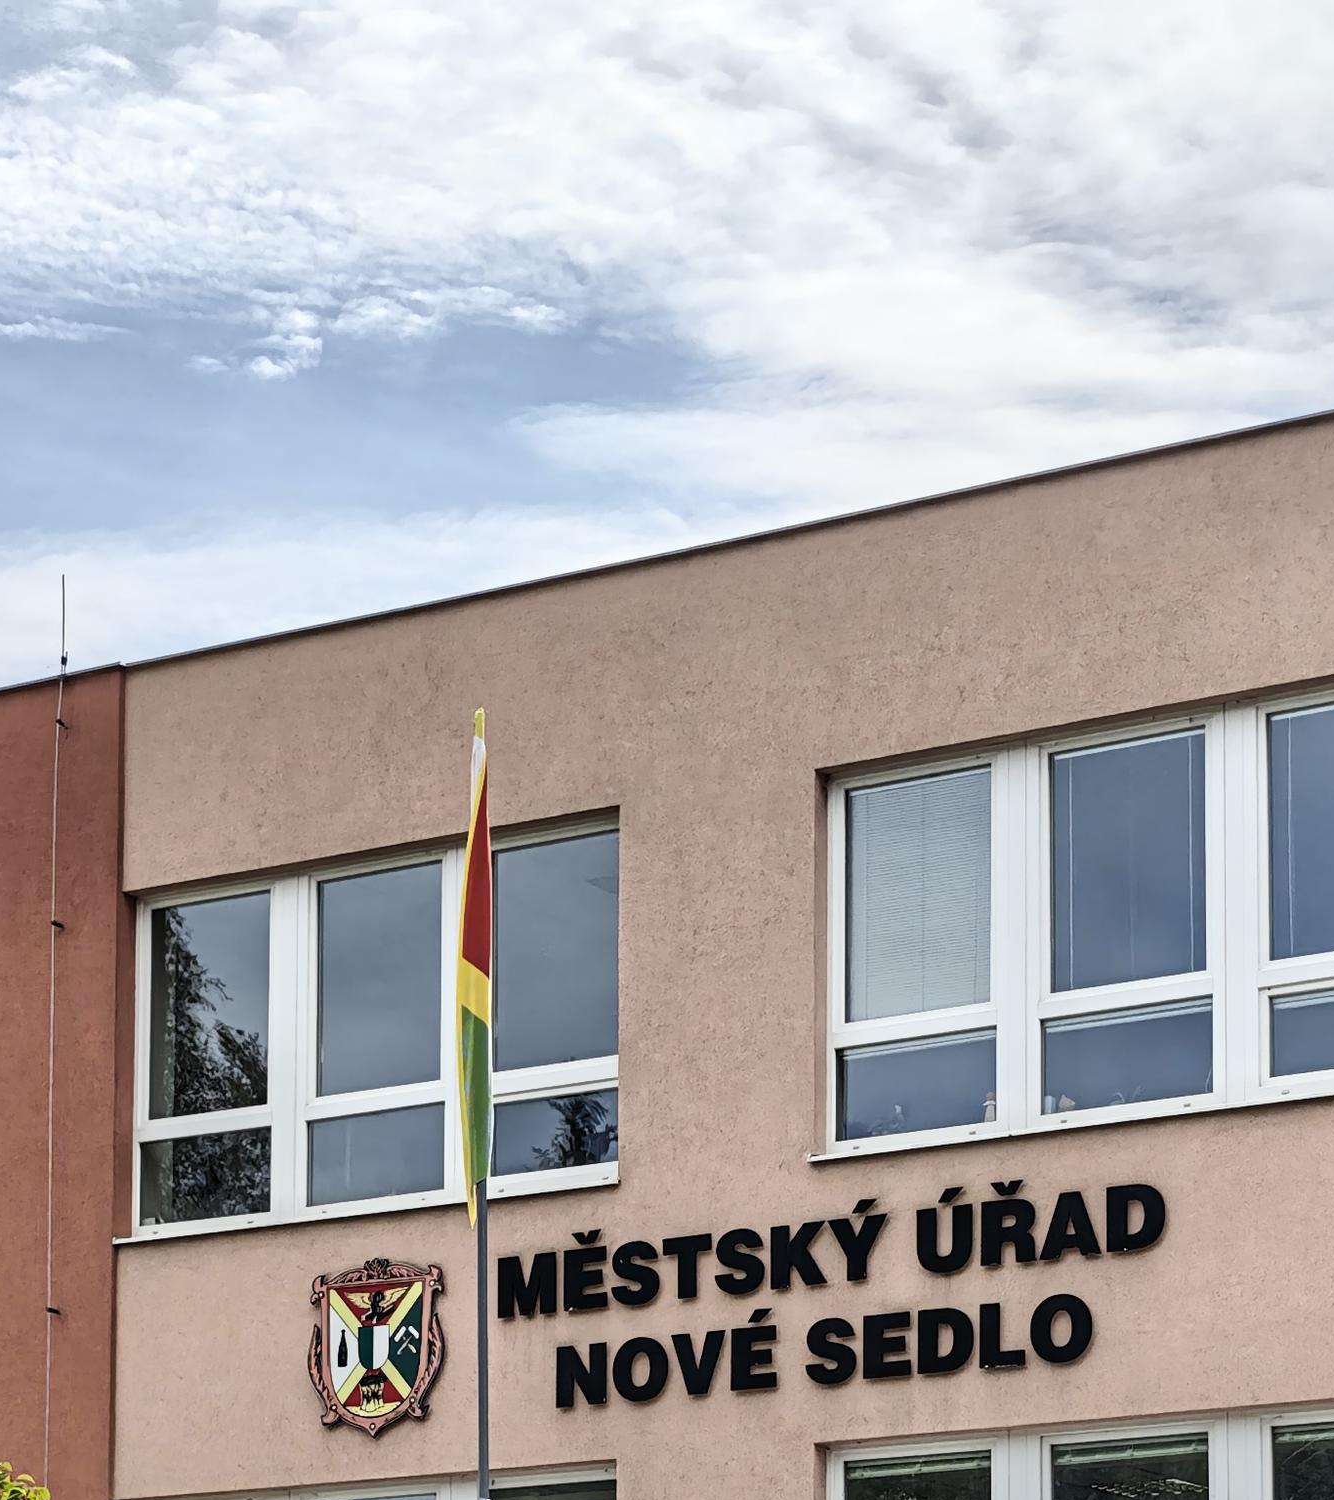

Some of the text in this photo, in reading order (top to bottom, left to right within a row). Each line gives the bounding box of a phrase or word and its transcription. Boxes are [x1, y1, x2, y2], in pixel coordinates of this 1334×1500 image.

[496, 1179, 1166, 1321] MĚSTSKÝ ÚŘAD
[555, 1293, 1094, 1409] NOVÉ SEDLO
